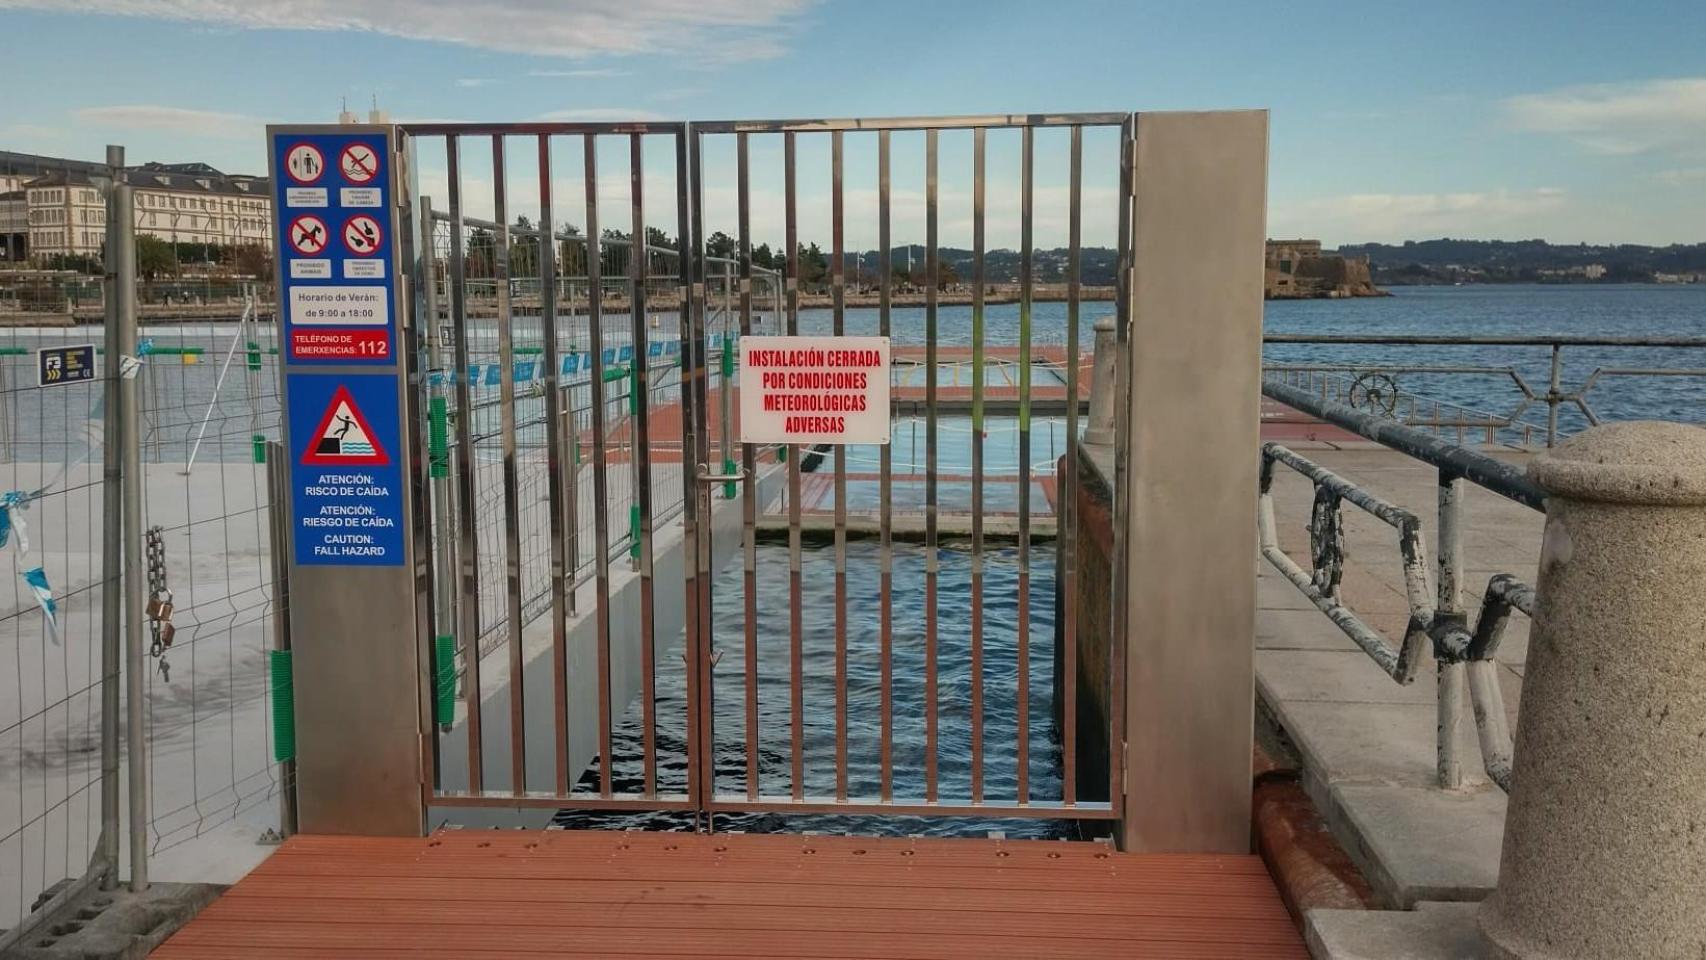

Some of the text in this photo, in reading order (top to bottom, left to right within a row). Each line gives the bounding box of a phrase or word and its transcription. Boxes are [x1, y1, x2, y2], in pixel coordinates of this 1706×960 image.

[298, 292, 379, 301] Horario de Verán:
[306, 309, 316, 317] de
[295, 334, 352, 343] TELÉFONO DE
[295, 340, 387, 355] EMERXENCIAS: 112
[749, 347, 881, 367] INSTALACIÓN CERRADA
[763, 372, 867, 389] POR CONDICIONES
[764, 391, 866, 411] METEOROLÓGICAS
[785, 416, 845, 433] ADVERSAS
[319, 473, 374, 484] ATENCIÓN:
[305, 485, 389, 496] RISCO DE CAÍDA
[319, 504, 376, 515] ATENCIÓN:
[303, 516, 394, 527] RIESGO DE CAÍDA
[324, 534, 374, 544] CAUTION:
[314, 546, 386, 556] FALL HAZARD
